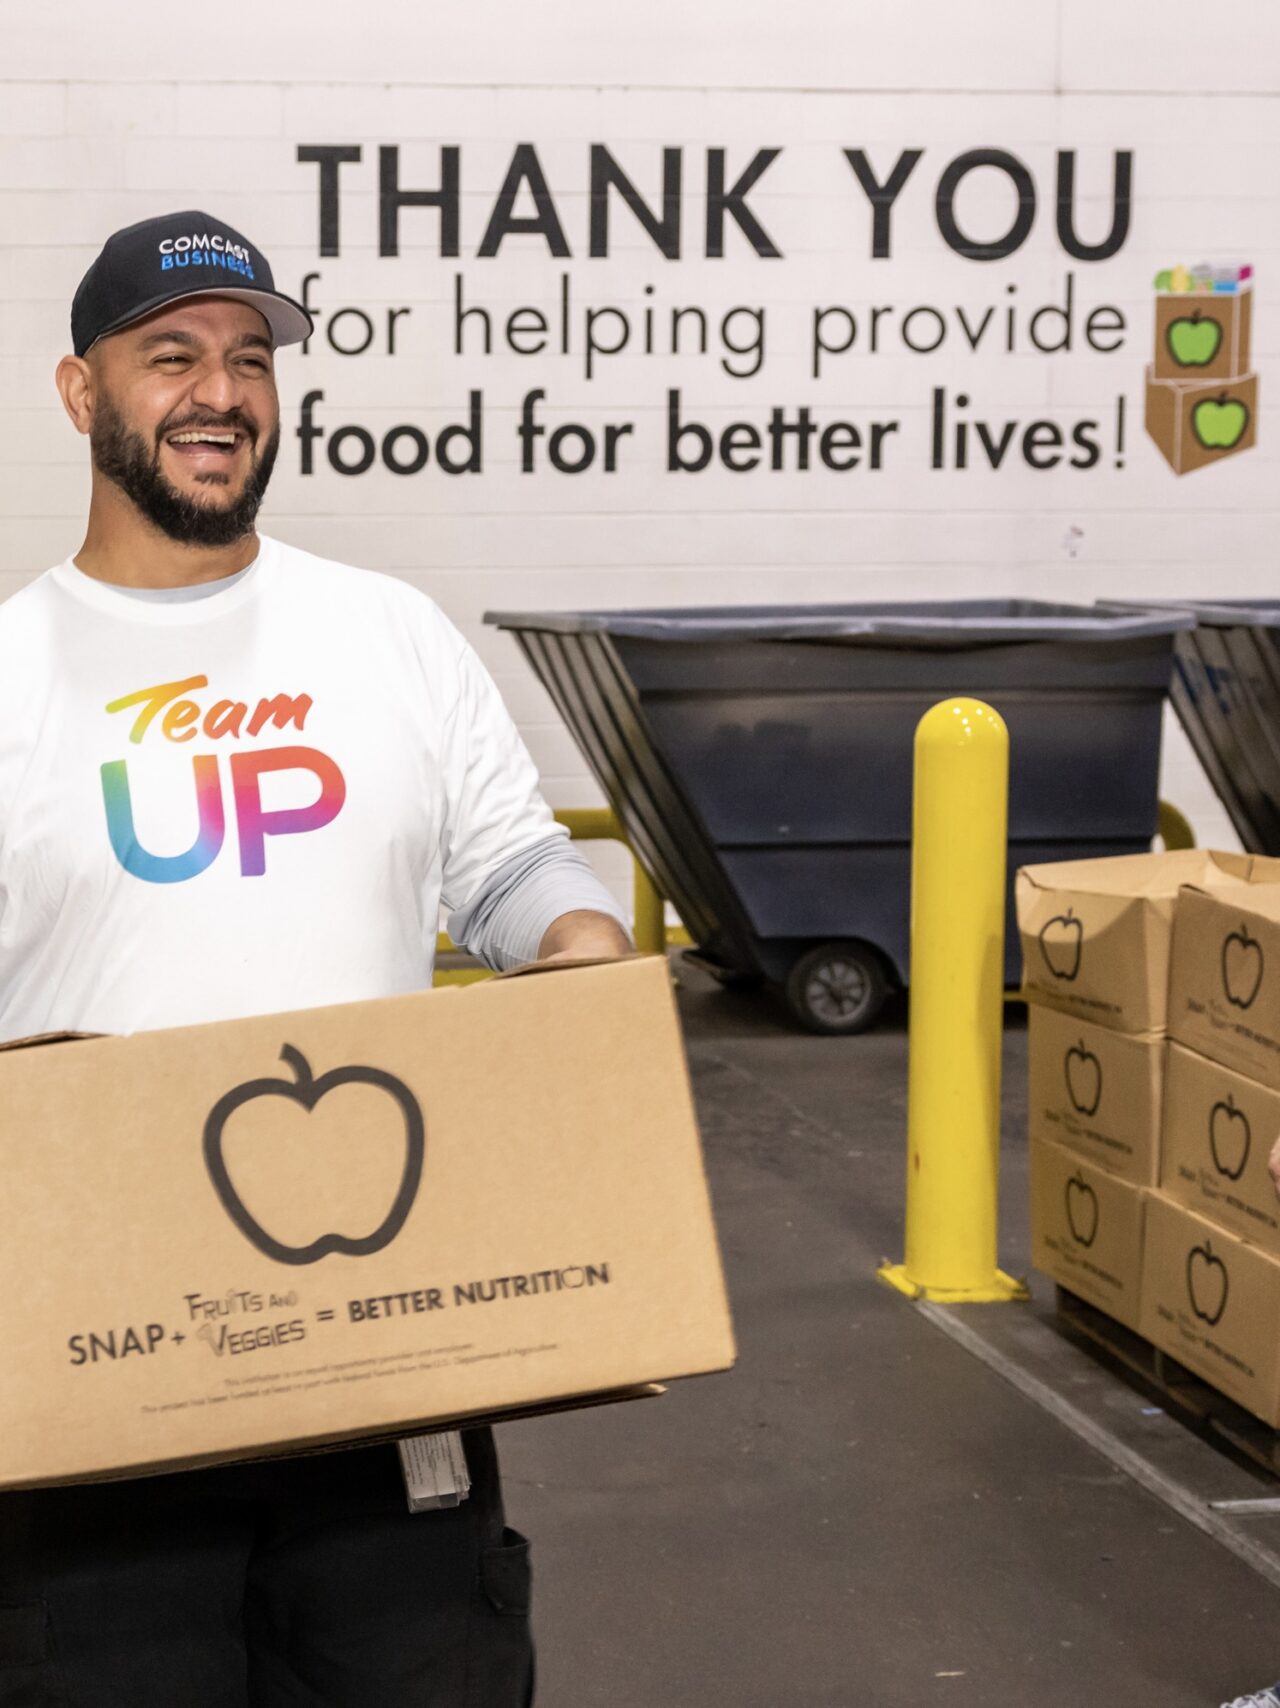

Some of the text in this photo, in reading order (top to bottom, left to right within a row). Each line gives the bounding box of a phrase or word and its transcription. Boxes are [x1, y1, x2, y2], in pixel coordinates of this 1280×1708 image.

[296, 142, 1134, 262] THANK YOU
[158, 233, 250, 264] COMCAST
[161, 250, 255, 281] BUSINESS
[299, 272, 1127, 381] for helping provide
[296, 387, 1127, 476] food for better lives!
[105, 674, 314, 745] Team
[100, 745, 347, 884] UP
[348, 1287, 445, 1323] BETTER
[452, 1262, 611, 1307] NUTRITION
[197, 1318, 307, 1358] VEGGIES
